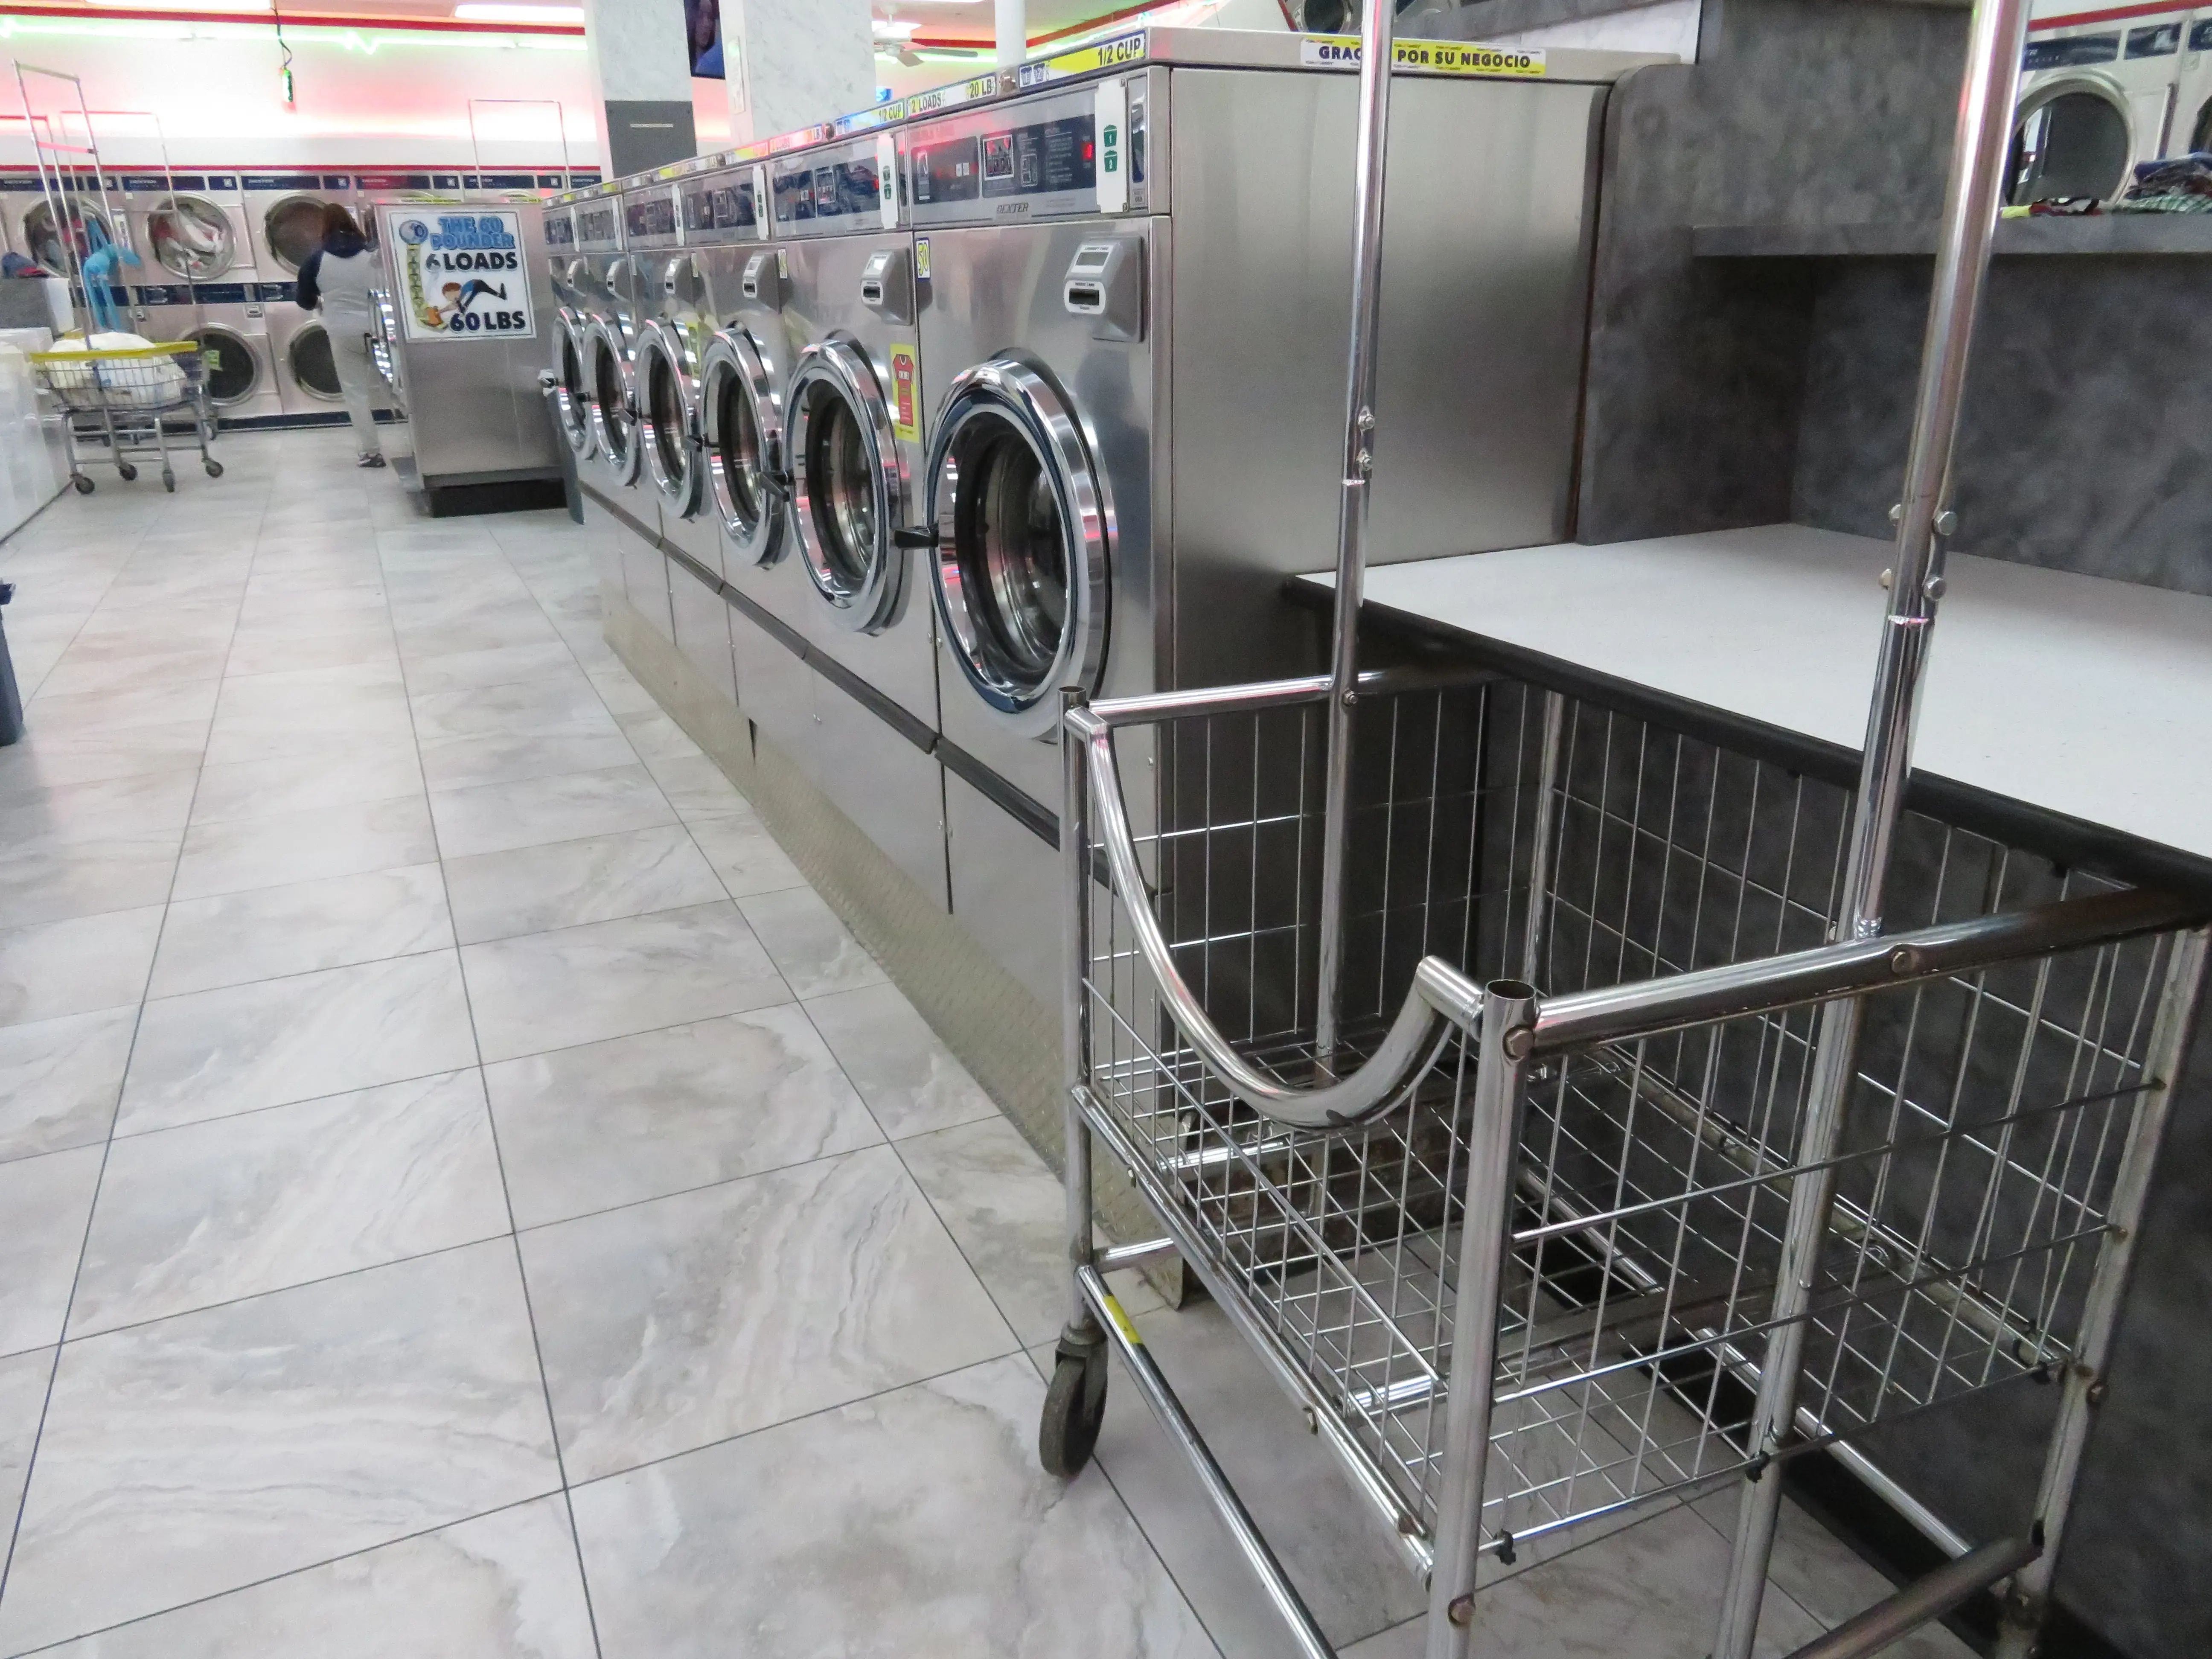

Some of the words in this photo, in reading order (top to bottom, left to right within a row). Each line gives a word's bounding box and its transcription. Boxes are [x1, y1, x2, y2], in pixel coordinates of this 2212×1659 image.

[1098, 45, 1113, 66] 1/2
[1117, 38, 1141, 61] CUP
[1319, 46, 1361, 61] GRAC
[1397, 49, 1429, 64] POR
[1435, 51, 1455, 64] SU
[1461, 53, 1530, 68] NEGOCIO
[970, 82, 979, 98] 20
[911, 99, 916, 112] 2
[918, 93, 941, 111] LOADS
[879, 109, 887, 123] 1/2
[889, 104, 901, 119] CUP
[997, 202, 1029, 213] DEXTER
[438, 216, 477, 233] THE
[478, 216, 504, 233] 60
[430, 233, 516, 250] POUNDER
[425, 253, 441, 272] 6
[443, 252, 518, 271] LOADS
[918, 242, 928, 276] 50
[450, 312, 480, 332] 60
[484, 311, 526, 330] LBS
